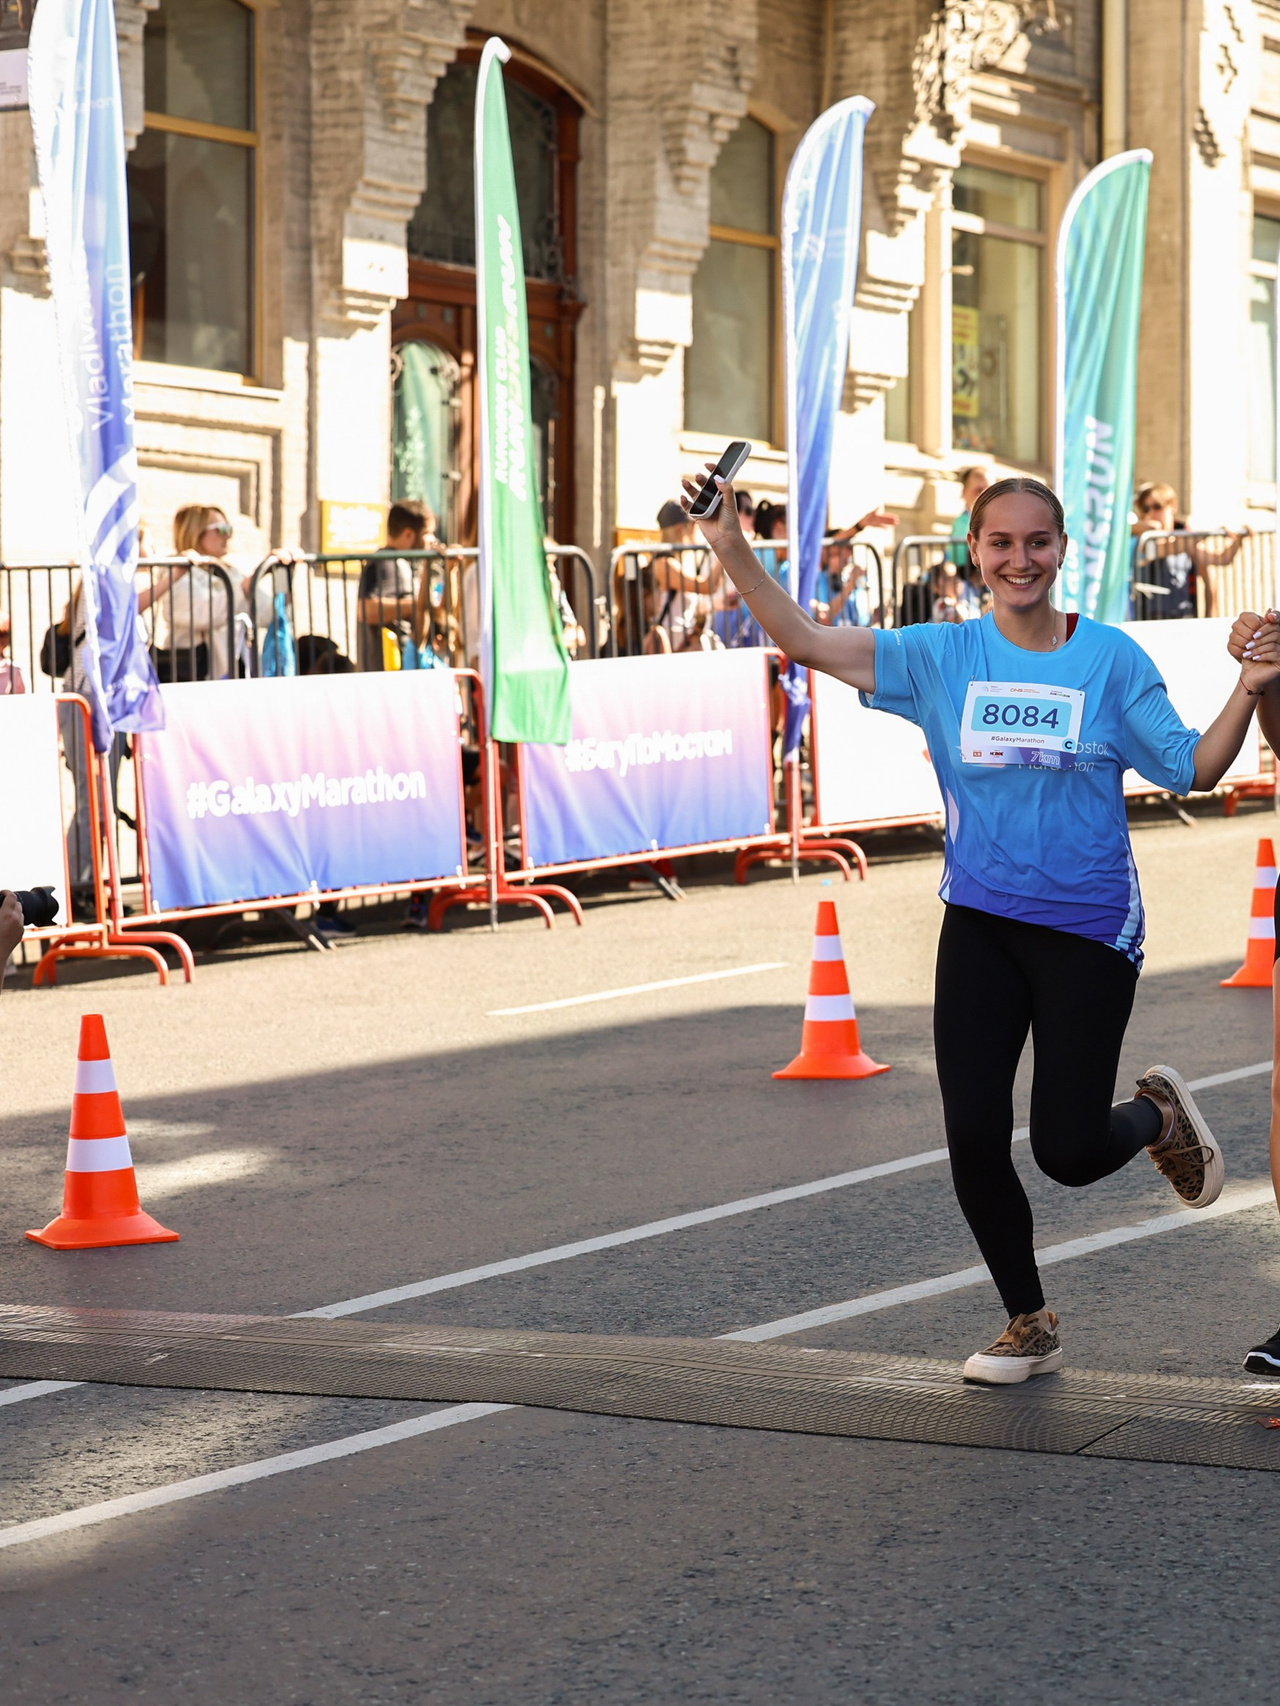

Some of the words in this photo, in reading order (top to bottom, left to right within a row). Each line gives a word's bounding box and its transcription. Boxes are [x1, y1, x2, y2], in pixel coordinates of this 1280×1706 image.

[982, 703, 1059, 729] 8084
[990, 735, 1045, 744] #GalaxyMarathon
[1064, 741, 1073, 749] C
[1031, 751, 1061, 766] 7km
[186, 766, 427, 819] #GalaxyMarathon
